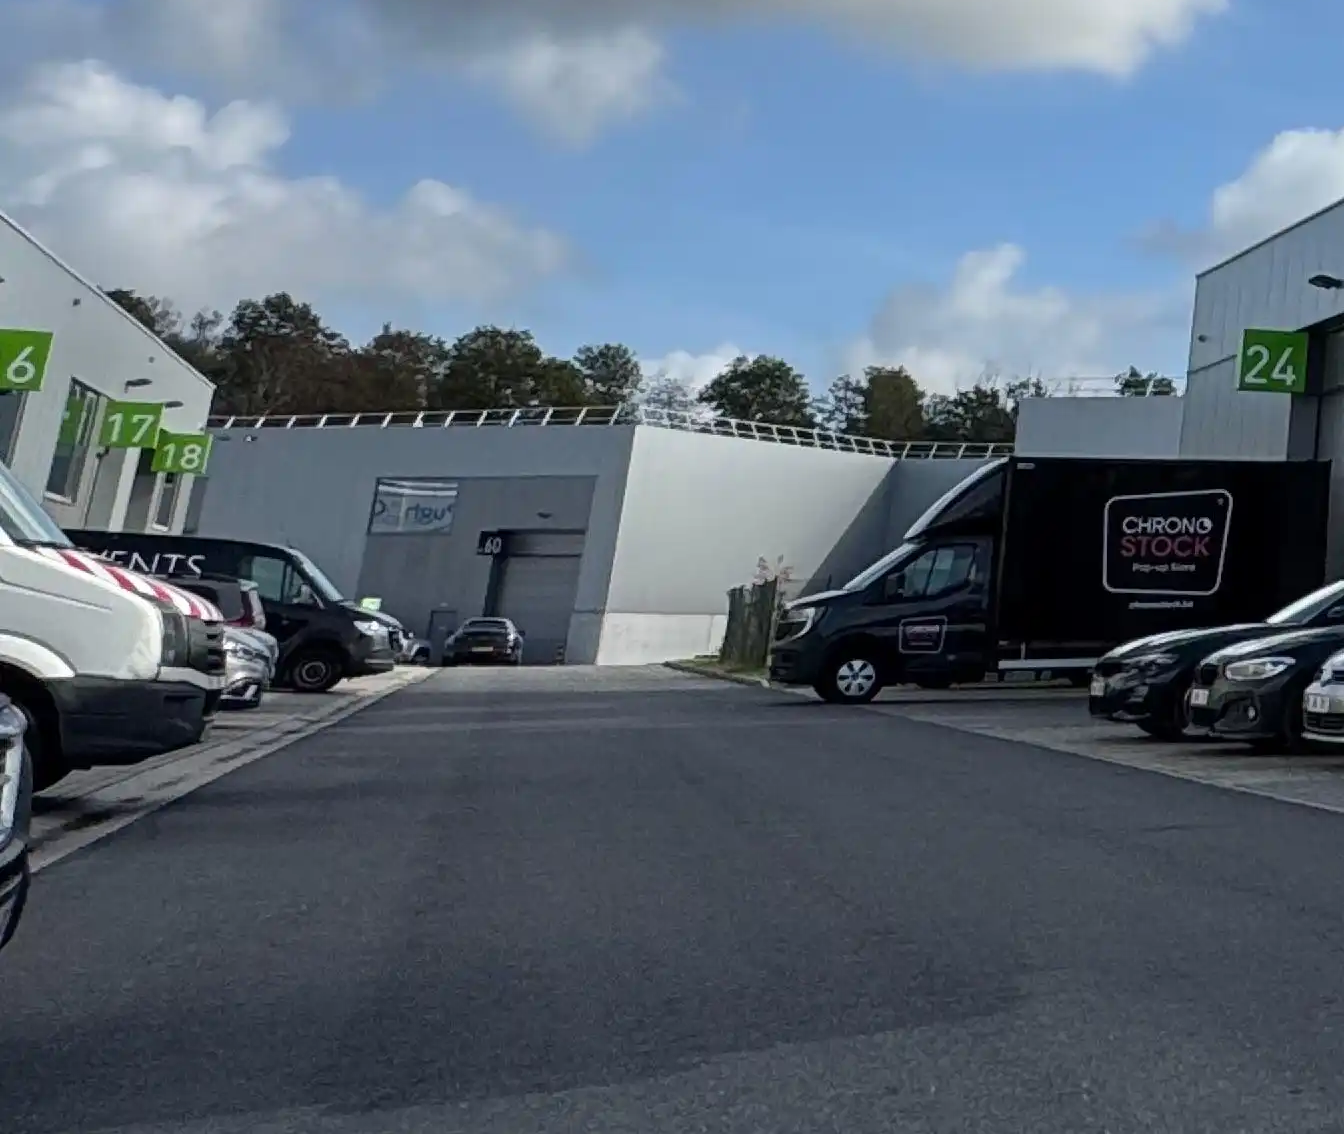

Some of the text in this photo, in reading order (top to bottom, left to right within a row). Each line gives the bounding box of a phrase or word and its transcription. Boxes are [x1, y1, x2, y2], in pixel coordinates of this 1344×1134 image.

[1243, 344, 1297, 386] 24
[107, 412, 156, 444] 17
[161, 443, 202, 470] 18
[1122, 516, 1213, 534] CHRONO
[483, 537, 503, 554] 60
[1120, 535, 1211, 557] STOCK
